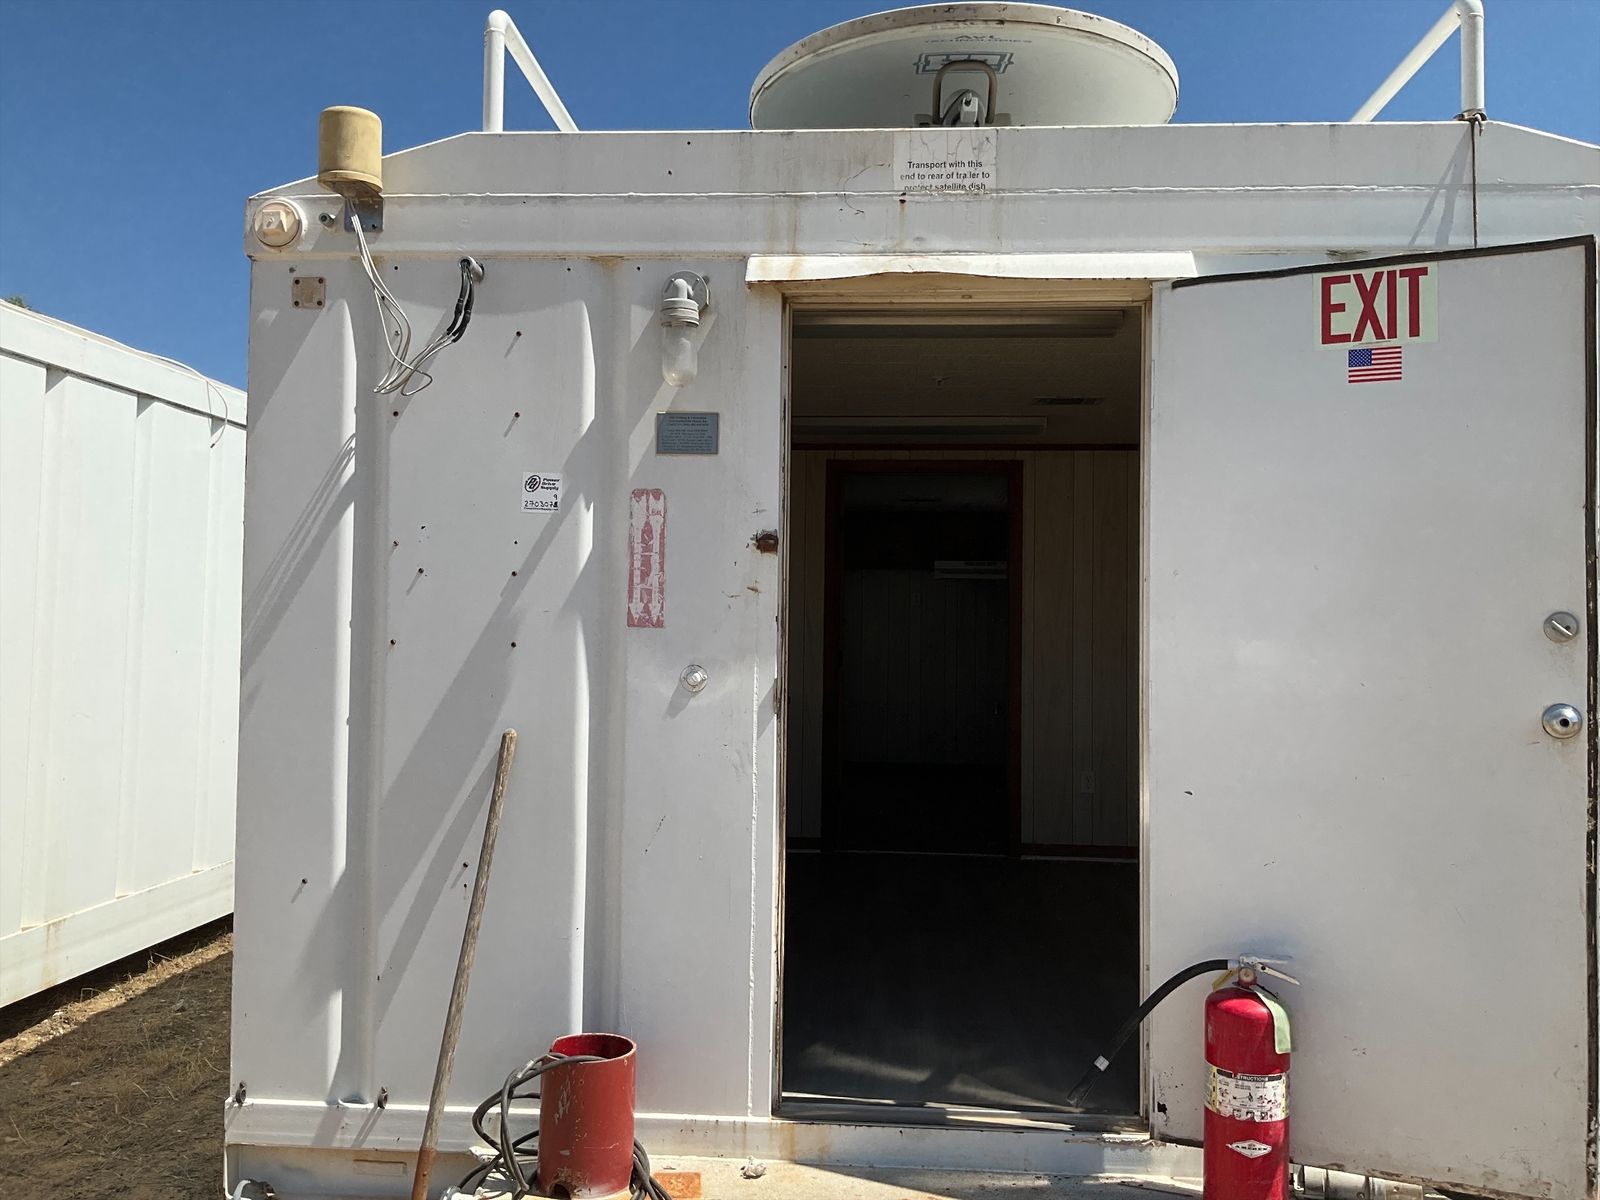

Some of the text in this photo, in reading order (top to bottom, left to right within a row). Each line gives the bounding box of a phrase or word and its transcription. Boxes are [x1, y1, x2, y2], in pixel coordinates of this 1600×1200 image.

[907, 159, 983, 170] Transport with this
[900, 172, 915, 181] end
[917, 172, 926, 180] to
[945, 172, 954, 180] of
[956, 171, 980, 180] traler
[981, 171, 990, 179] to
[934, 182, 966, 191] satellite
[968, 182, 986, 191] dish
[1321, 266, 1429, 345] EXIT
[524, 500, 559, 508] 270307
